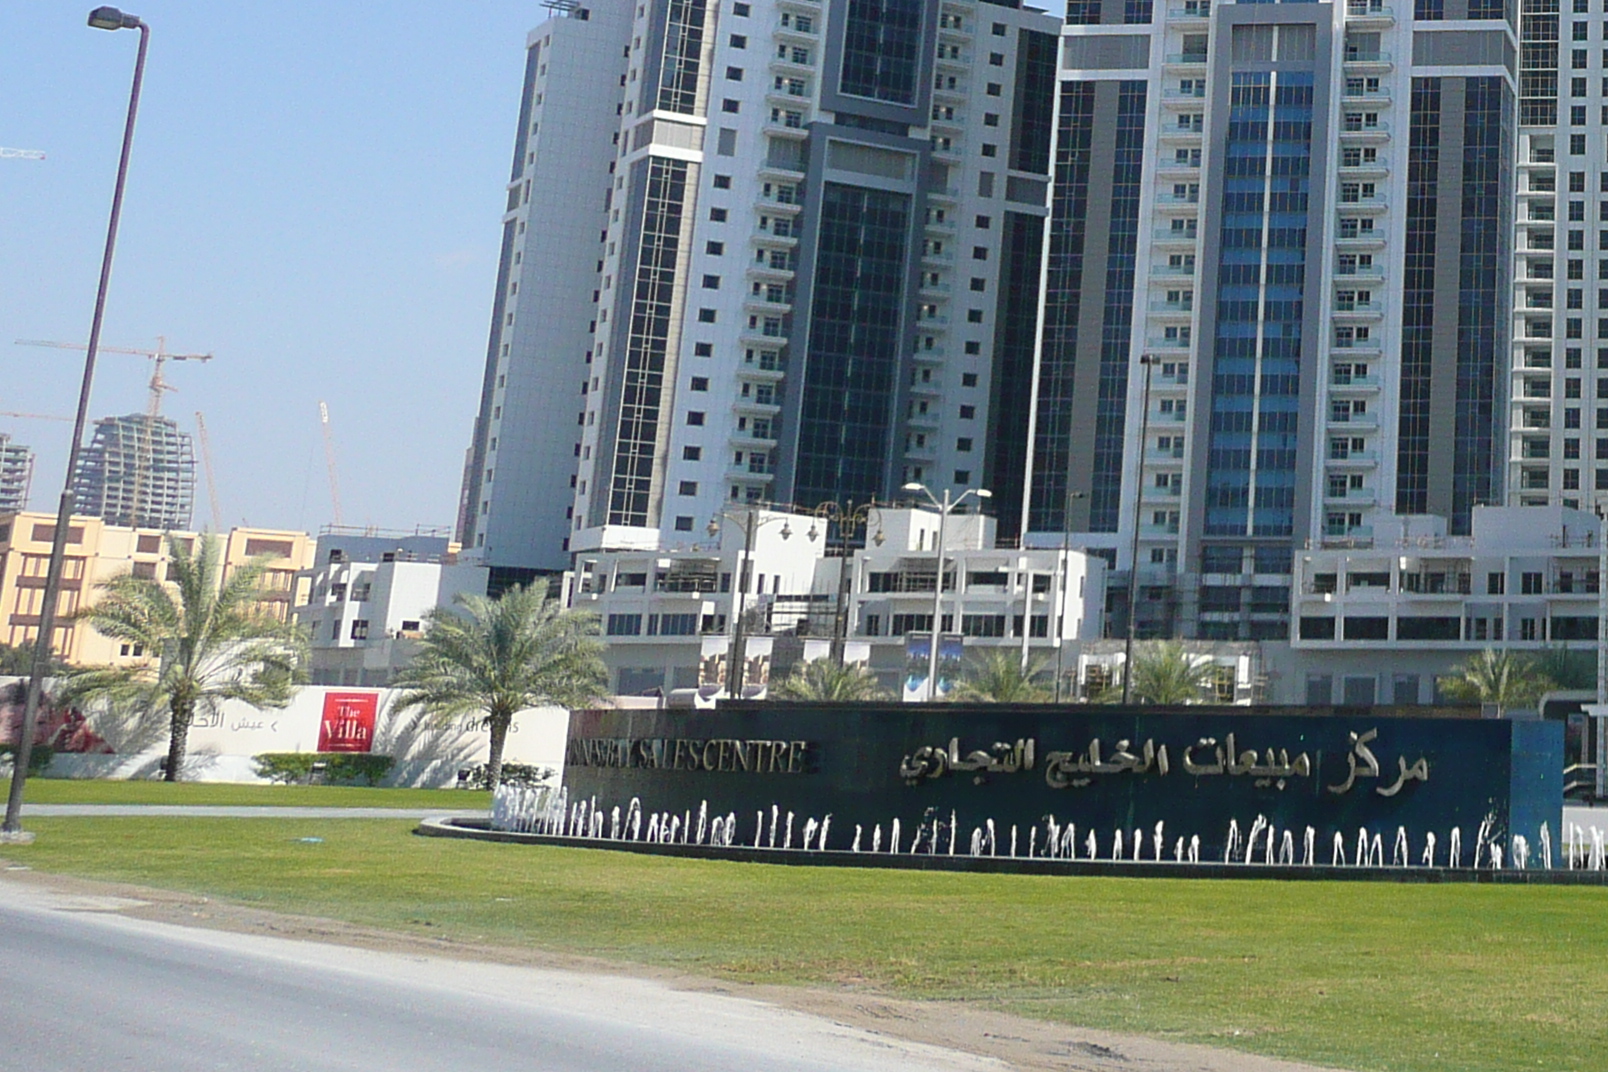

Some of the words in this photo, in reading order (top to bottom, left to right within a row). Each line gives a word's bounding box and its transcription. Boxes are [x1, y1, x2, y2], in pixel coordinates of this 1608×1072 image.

[324, 719, 367, 739] Villa
[337, 705, 361, 718] The
[466, 716, 519, 733] dres
[638, 738, 700, 771] SALES
[702, 738, 806, 773] CENTRE
[900, 737, 1035, 786] التجاري
[1046, 736, 1170, 788] الخليج
[1182, 732, 1311, 790] مبيعات
[1327, 727, 1428, 796] مركز
